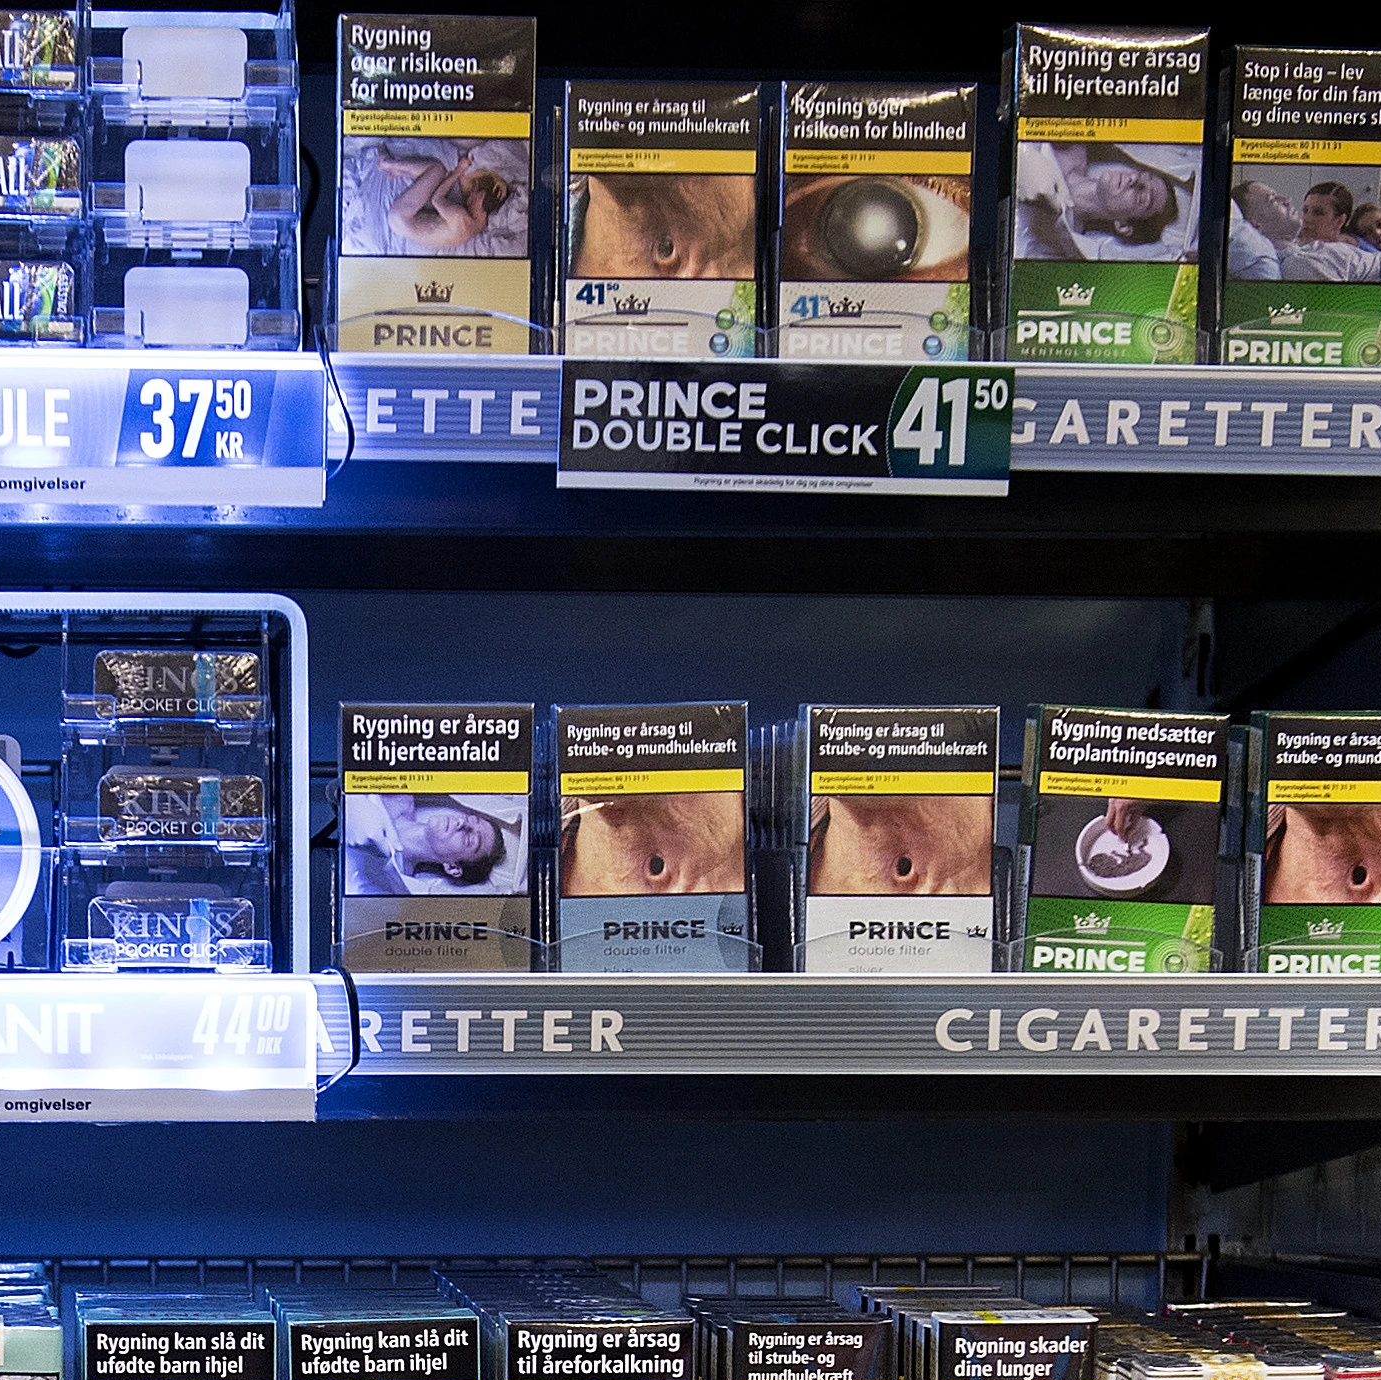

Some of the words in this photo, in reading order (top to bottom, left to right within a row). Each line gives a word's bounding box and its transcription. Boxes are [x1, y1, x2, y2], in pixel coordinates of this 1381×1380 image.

[1244, 83, 1292, 104] længe
[1297, 84, 1319, 101] for
[1323, 85, 1347, 101] din
[374, 324, 492, 347] PRINCE
[1229, 340, 1342, 364] PRINCE
[214, 380, 250, 419] 50
[574, 379, 766, 418] PRINCE
[140, 379, 213, 458] 37
[891, 377, 968, 465] 41
[970, 378, 1004, 410] 50
[215, 431, 243, 459] KR
[573, 419, 742, 452] DOUBLE
[757, 423, 878, 455] CLICK
[352, 740, 371, 760] til
[379, 740, 499, 766] hjerteanfald
[604, 920, 705, 940] PRINCE
[604, 946, 650, 956] double
[655, 944, 686, 954] filter
